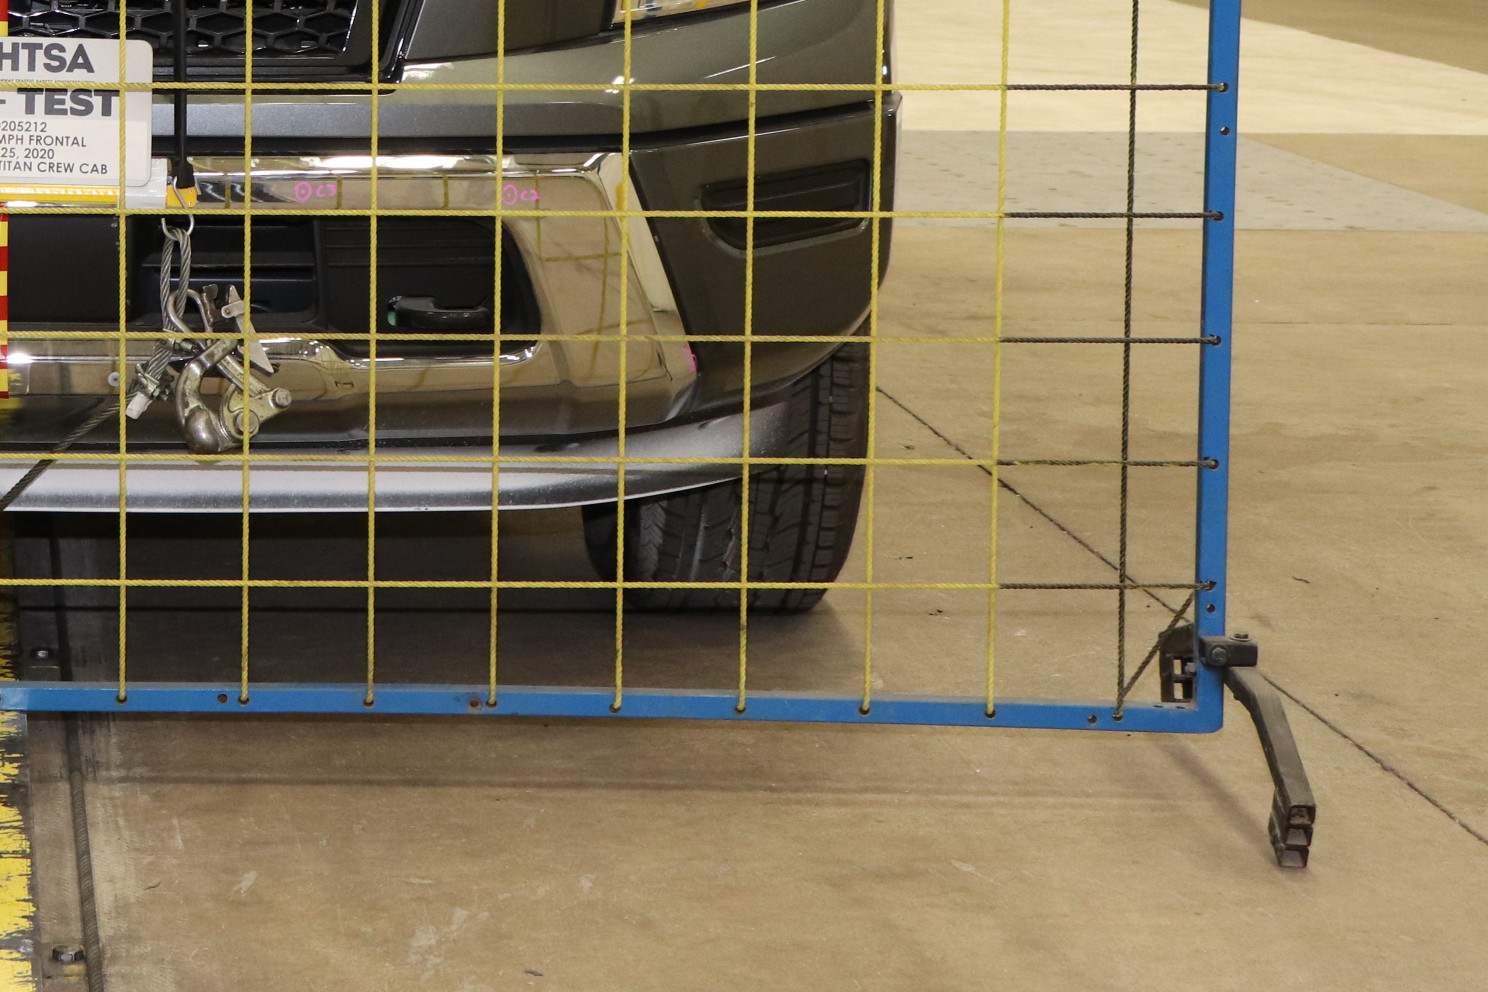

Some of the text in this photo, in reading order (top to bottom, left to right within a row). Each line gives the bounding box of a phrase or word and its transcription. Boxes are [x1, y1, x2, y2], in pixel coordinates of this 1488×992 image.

[17, 88, 122, 117] TEST
[29, 135, 87, 147] FRONTAL
[0, 147, 19, 159] 25,
[24, 148, 55, 159] 2020
[37, 162, 75, 173] CREW
[79, 163, 108, 175] CAB
